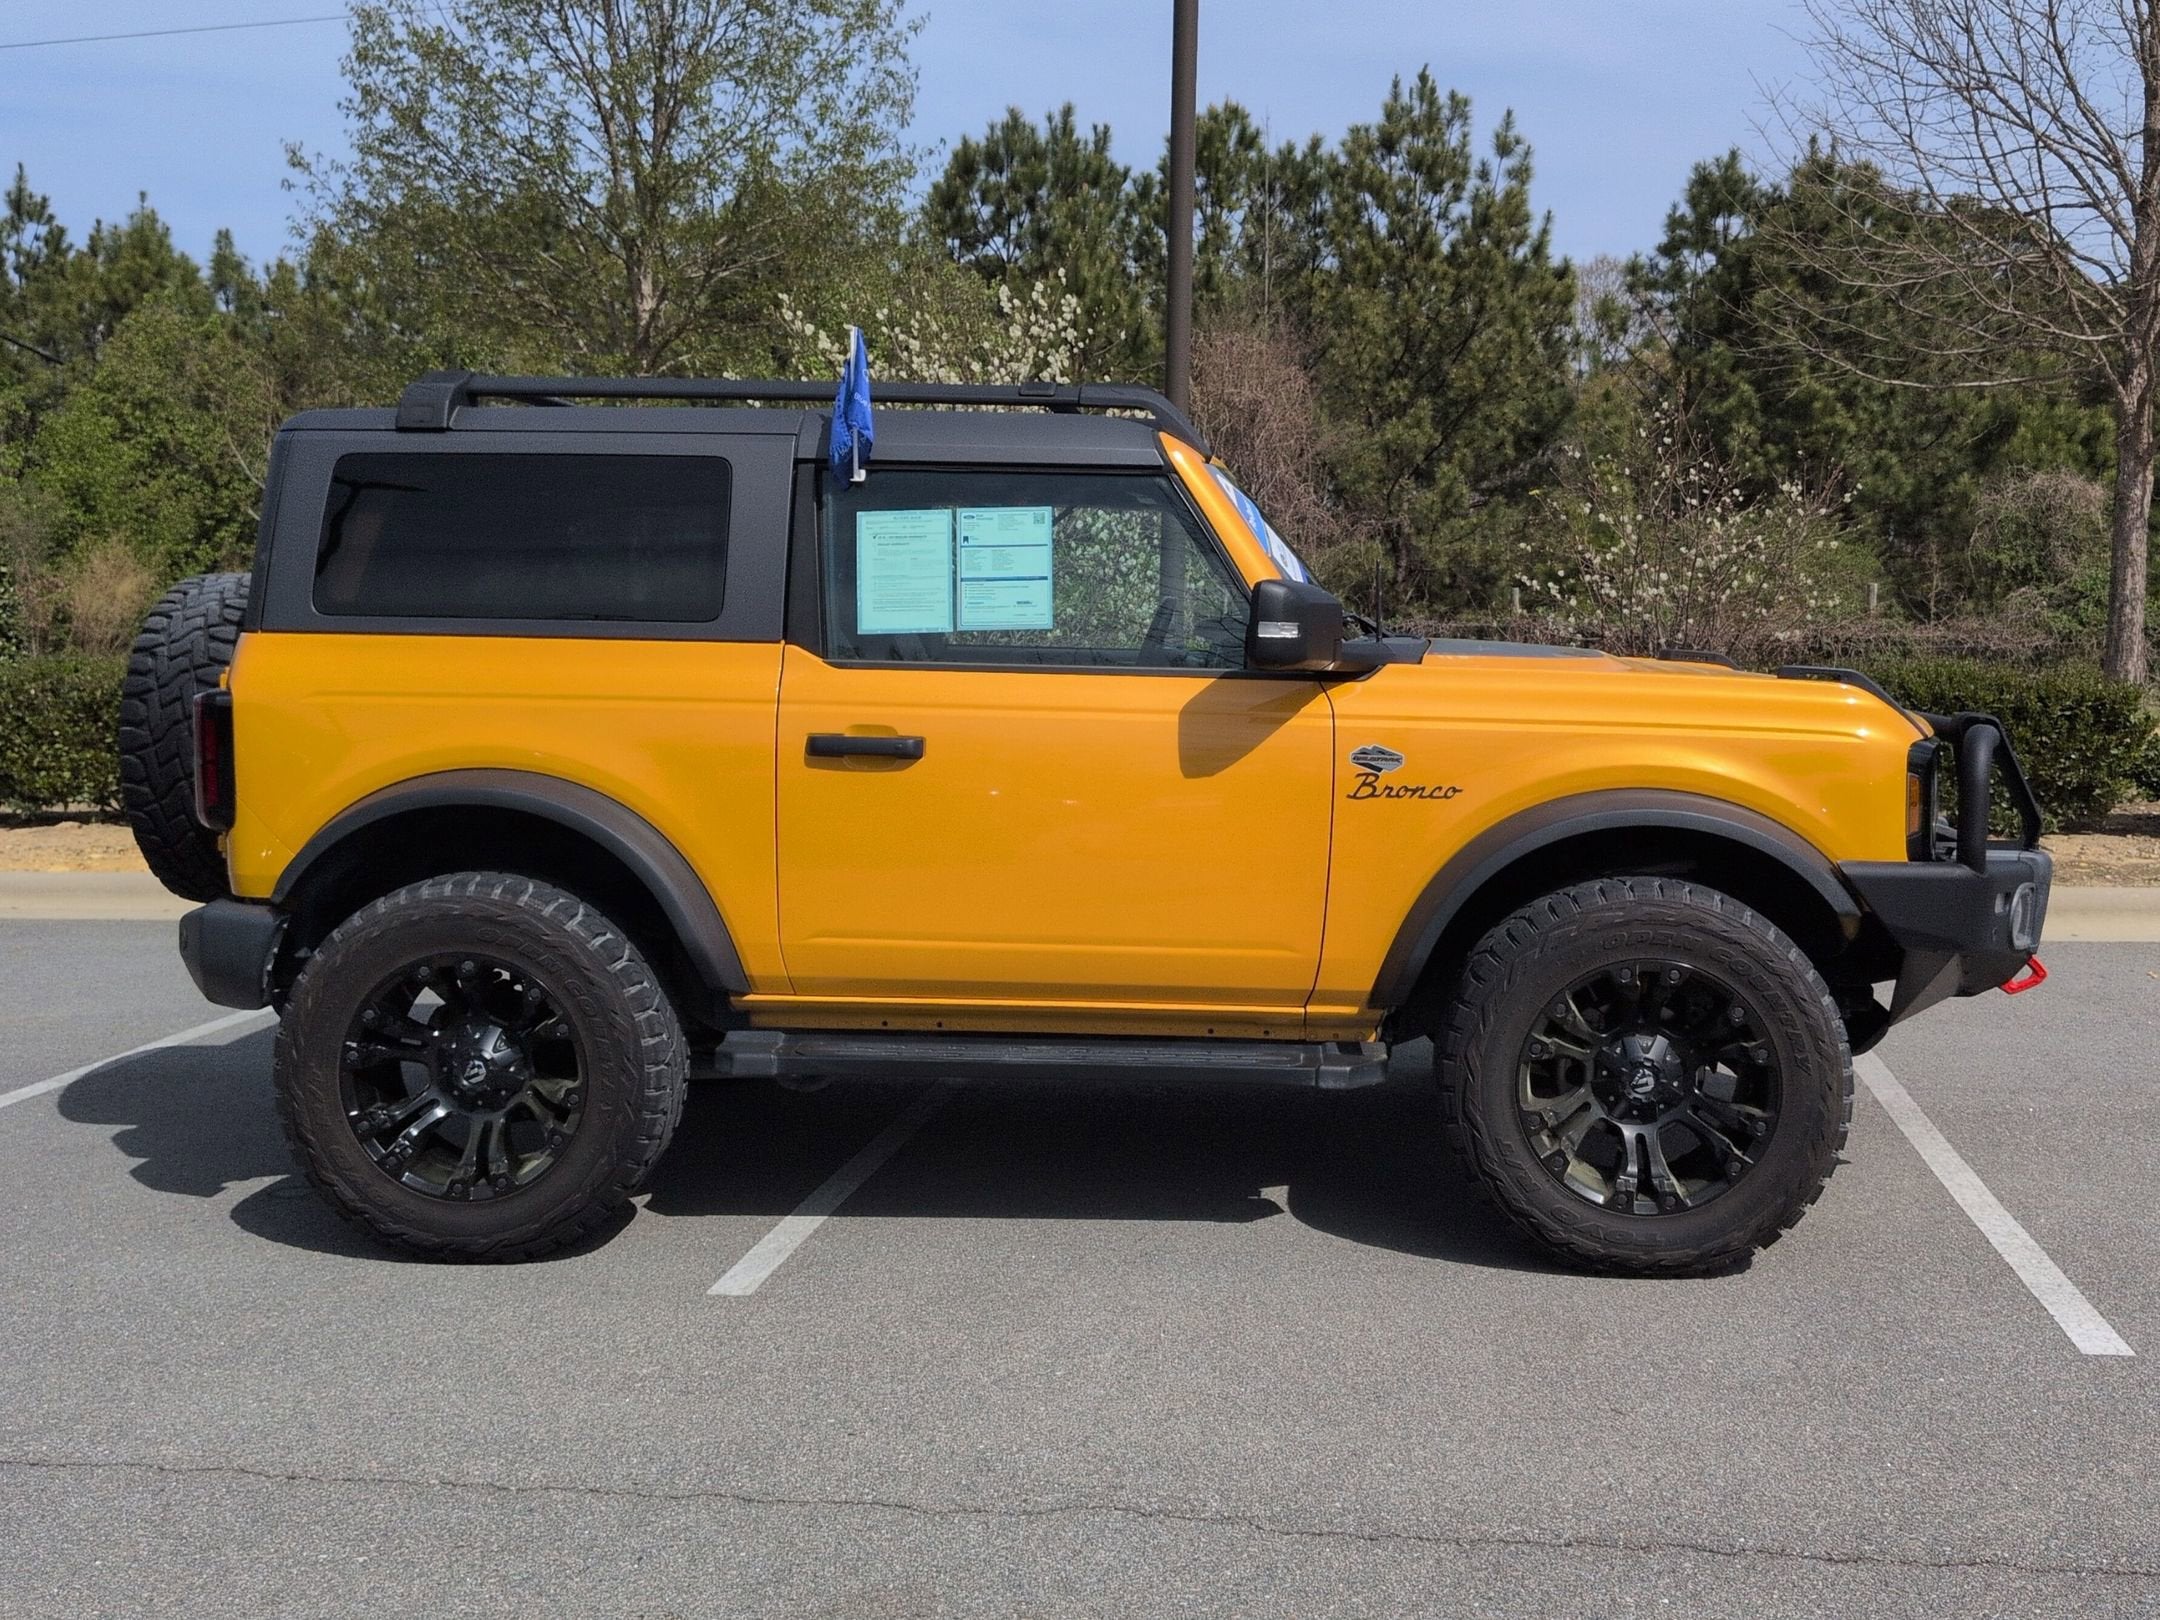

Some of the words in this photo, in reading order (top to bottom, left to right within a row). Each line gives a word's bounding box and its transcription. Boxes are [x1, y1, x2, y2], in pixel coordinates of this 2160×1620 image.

[1347, 773, 1464, 800] Bronco
[1600, 929, 1704, 952] OPEN
[1708, 945, 1813, 1077] COUNTRY
